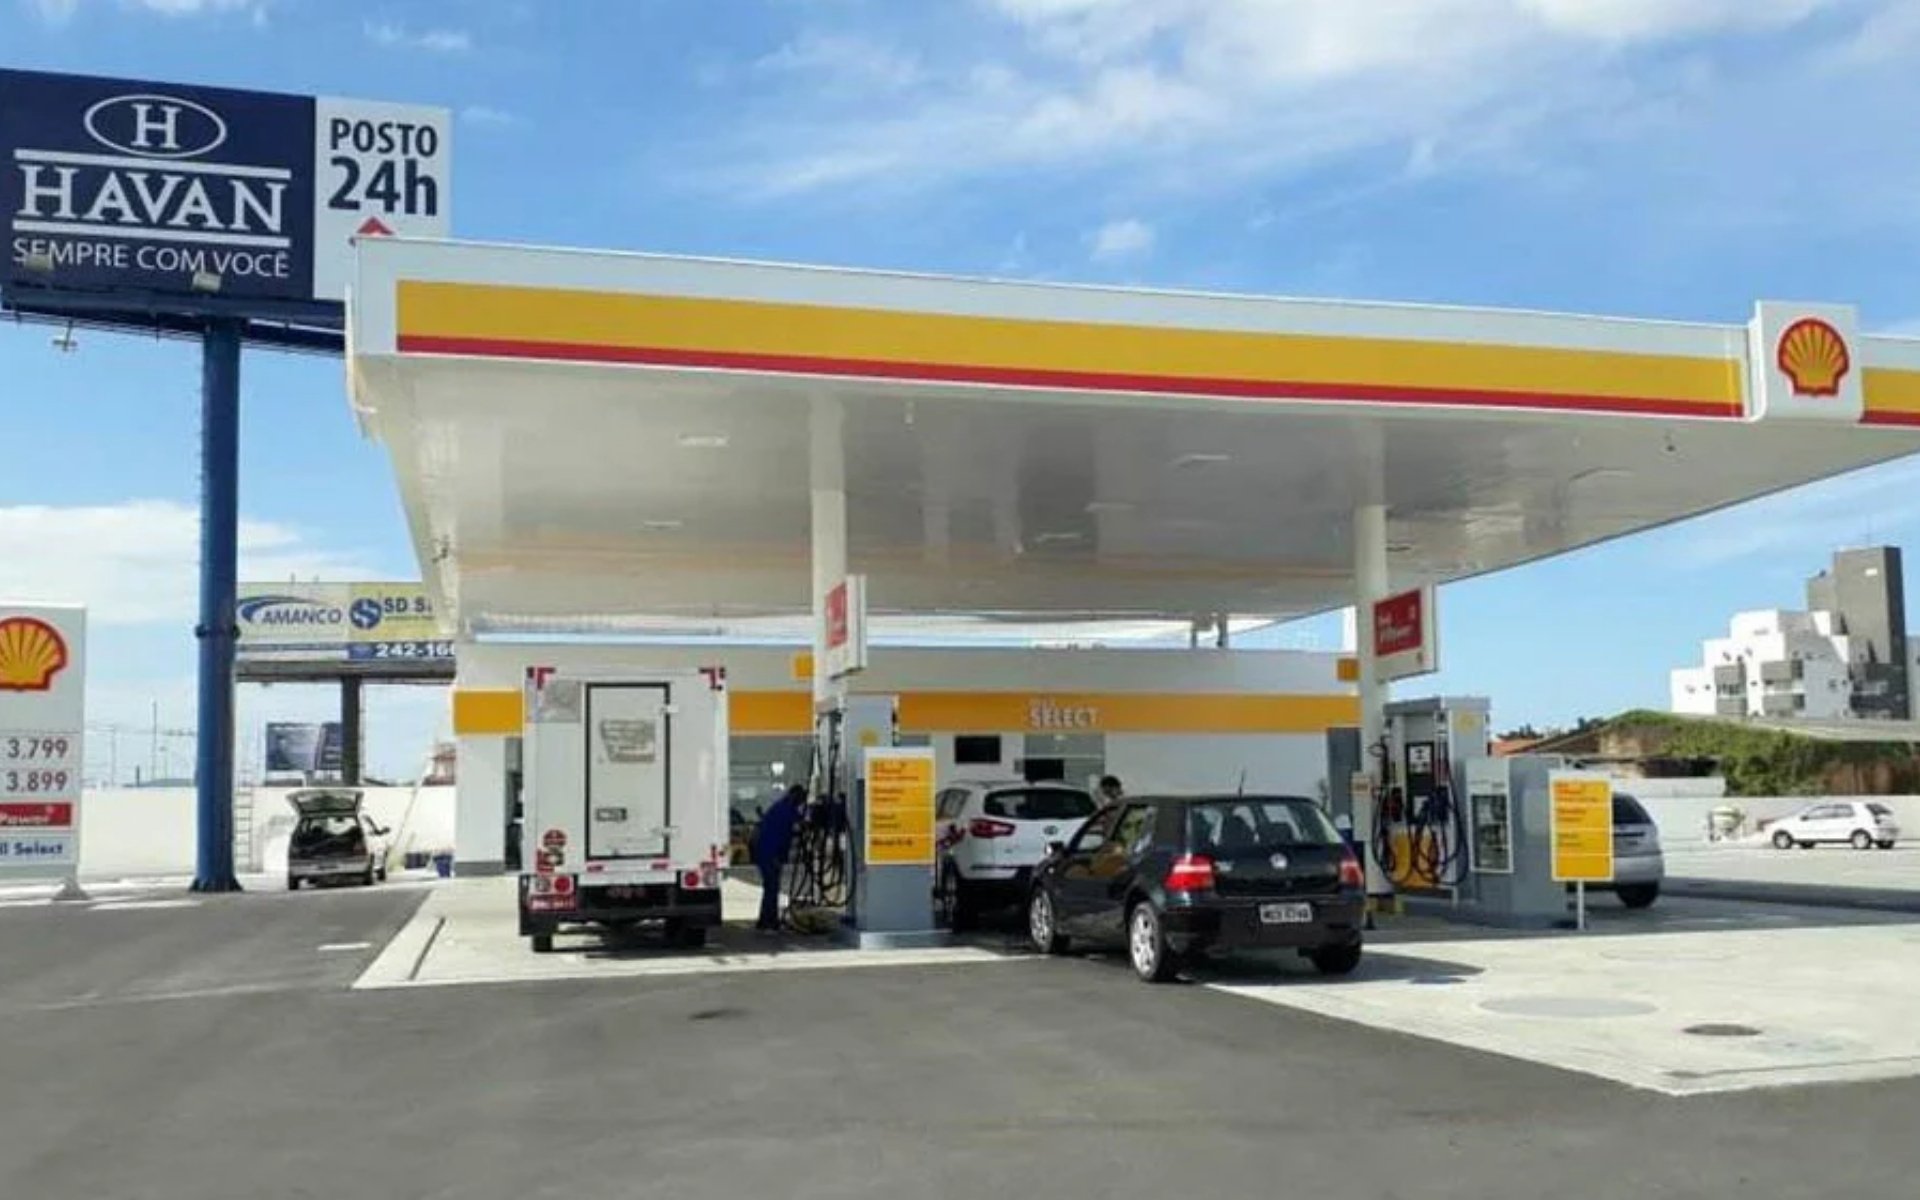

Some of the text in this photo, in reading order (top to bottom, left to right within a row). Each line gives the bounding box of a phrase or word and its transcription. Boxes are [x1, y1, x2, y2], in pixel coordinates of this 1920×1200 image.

[132, 103, 181, 149] H
[330, 118, 437, 157] POSTO
[17, 163, 289, 234] HAVAN
[328, 156, 437, 216] 24h
[13, 238, 290, 278] SEMPRE COM VOCÊ
[263, 608, 342, 624] AMANCO
[8, 739, 68, 758] 3.799
[6, 772, 67, 791] 3.899
